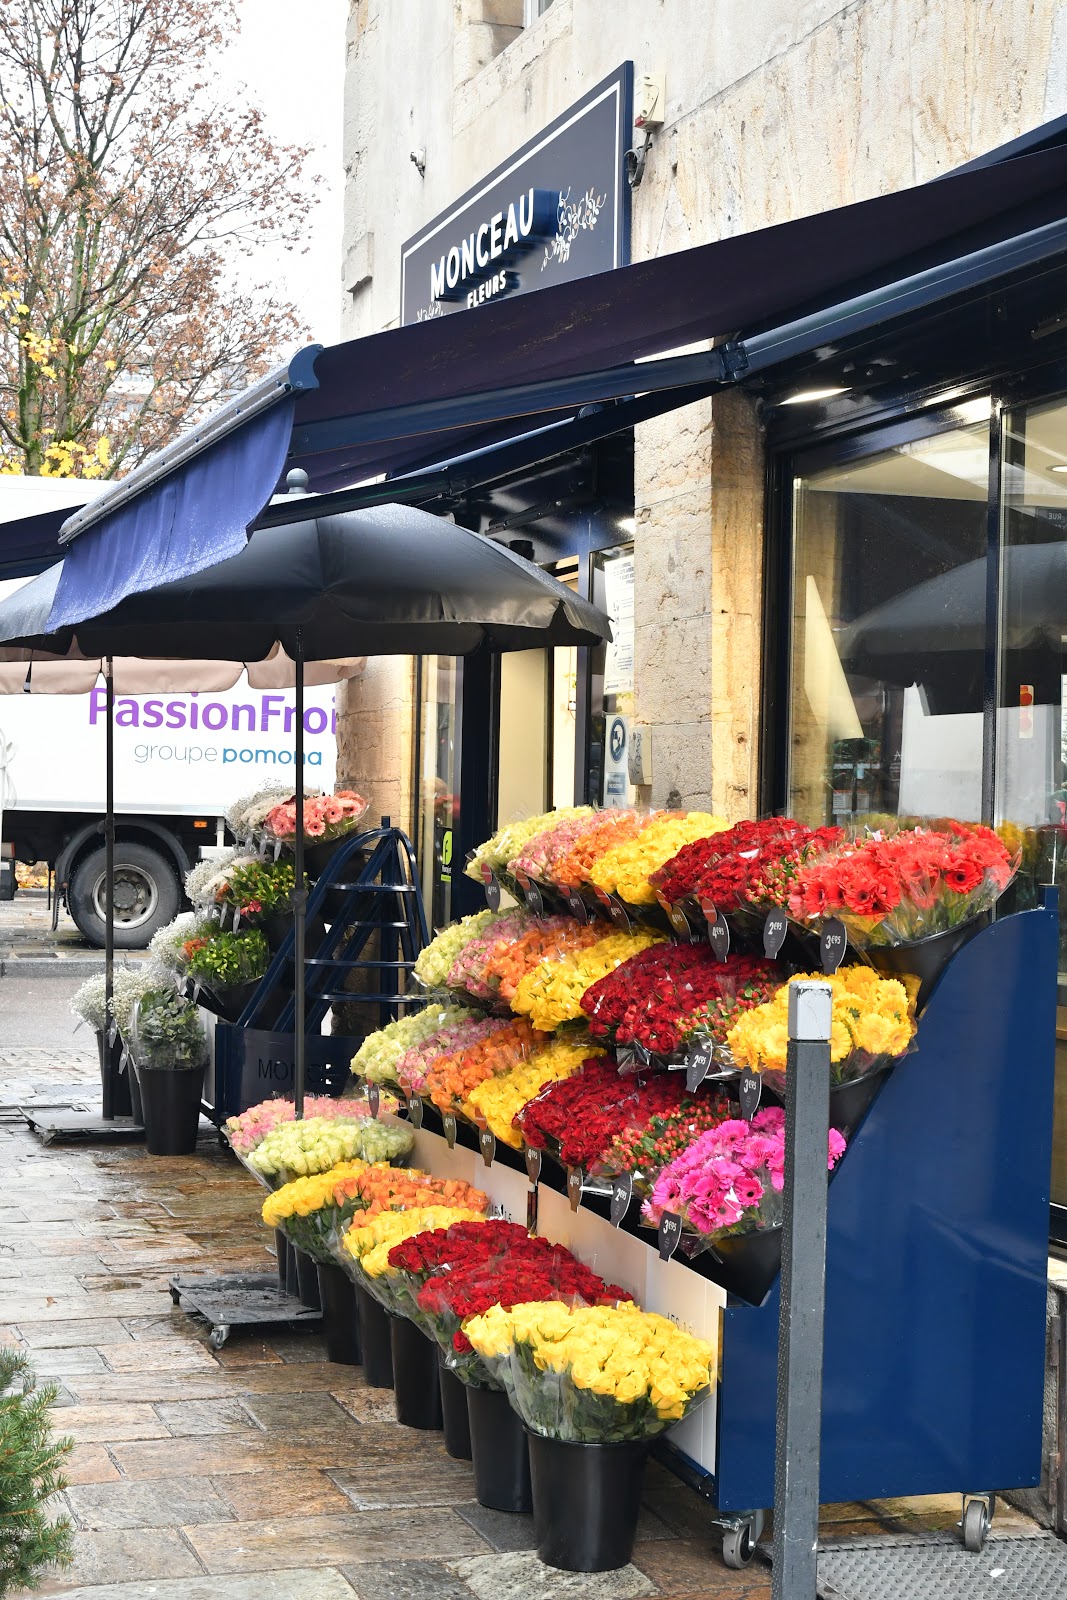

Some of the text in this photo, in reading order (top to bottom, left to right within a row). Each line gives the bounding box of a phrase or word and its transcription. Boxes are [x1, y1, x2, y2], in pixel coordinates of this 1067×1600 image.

[430, 188, 534, 301] MONCEAU
[466, 270, 507, 309] FLEURS
[134, 744, 218, 764] groupe
[768, 921, 783, 935] 2€95
[825, 935, 841, 950] 3€95
[692, 1054, 708, 1068] 2€95
[743, 1078, 758, 1093] 3€95
[616, 1187, 628, 1202] 2€95
[663, 1219, 677, 1234] 3€95
